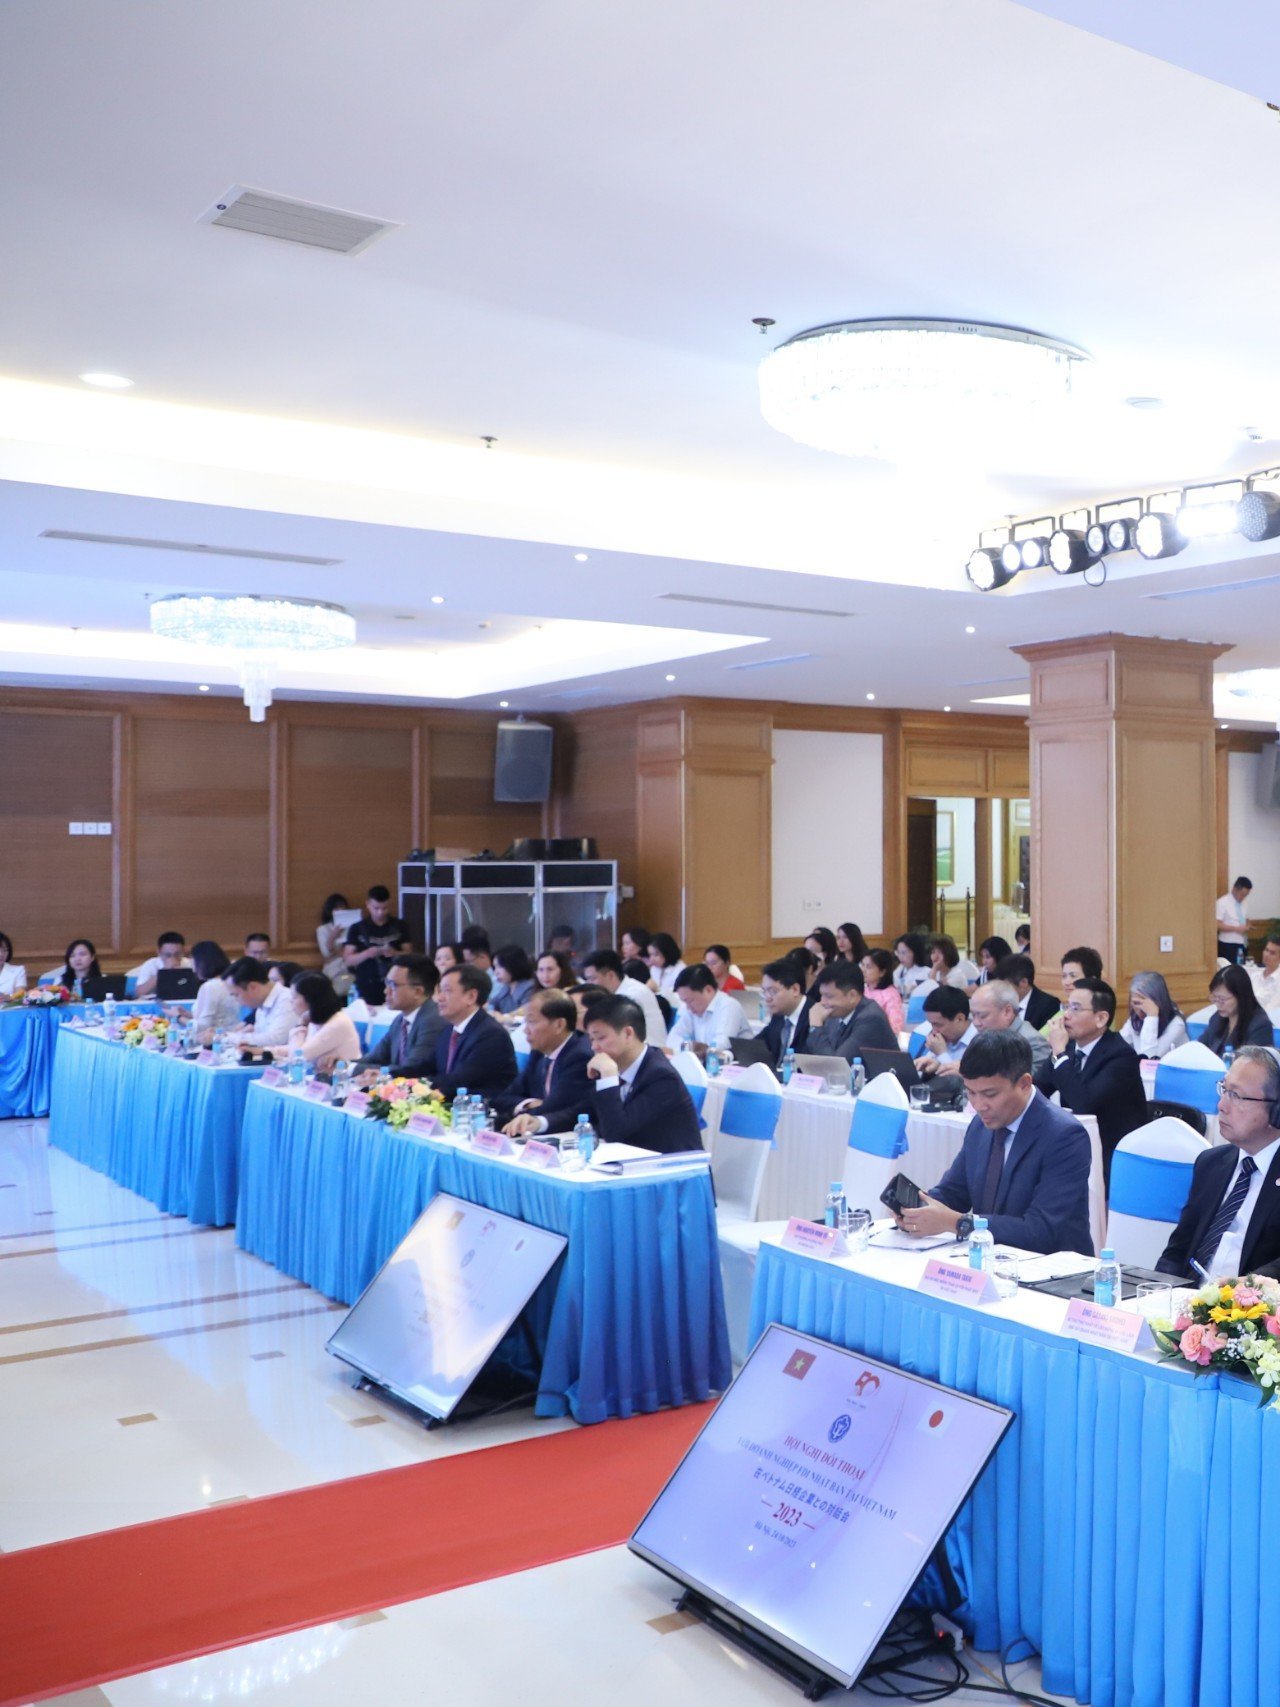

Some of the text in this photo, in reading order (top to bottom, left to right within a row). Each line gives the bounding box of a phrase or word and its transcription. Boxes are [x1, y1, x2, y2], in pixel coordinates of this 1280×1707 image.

[784, 1434, 801, 1450] HỘI
[802, 1442, 821, 1462] NGHỊ
[837, 1460, 866, 1481] THOẠI
[772, 1502, 802, 1527] 2023
[879, 1504, 897, 1520] NAM
